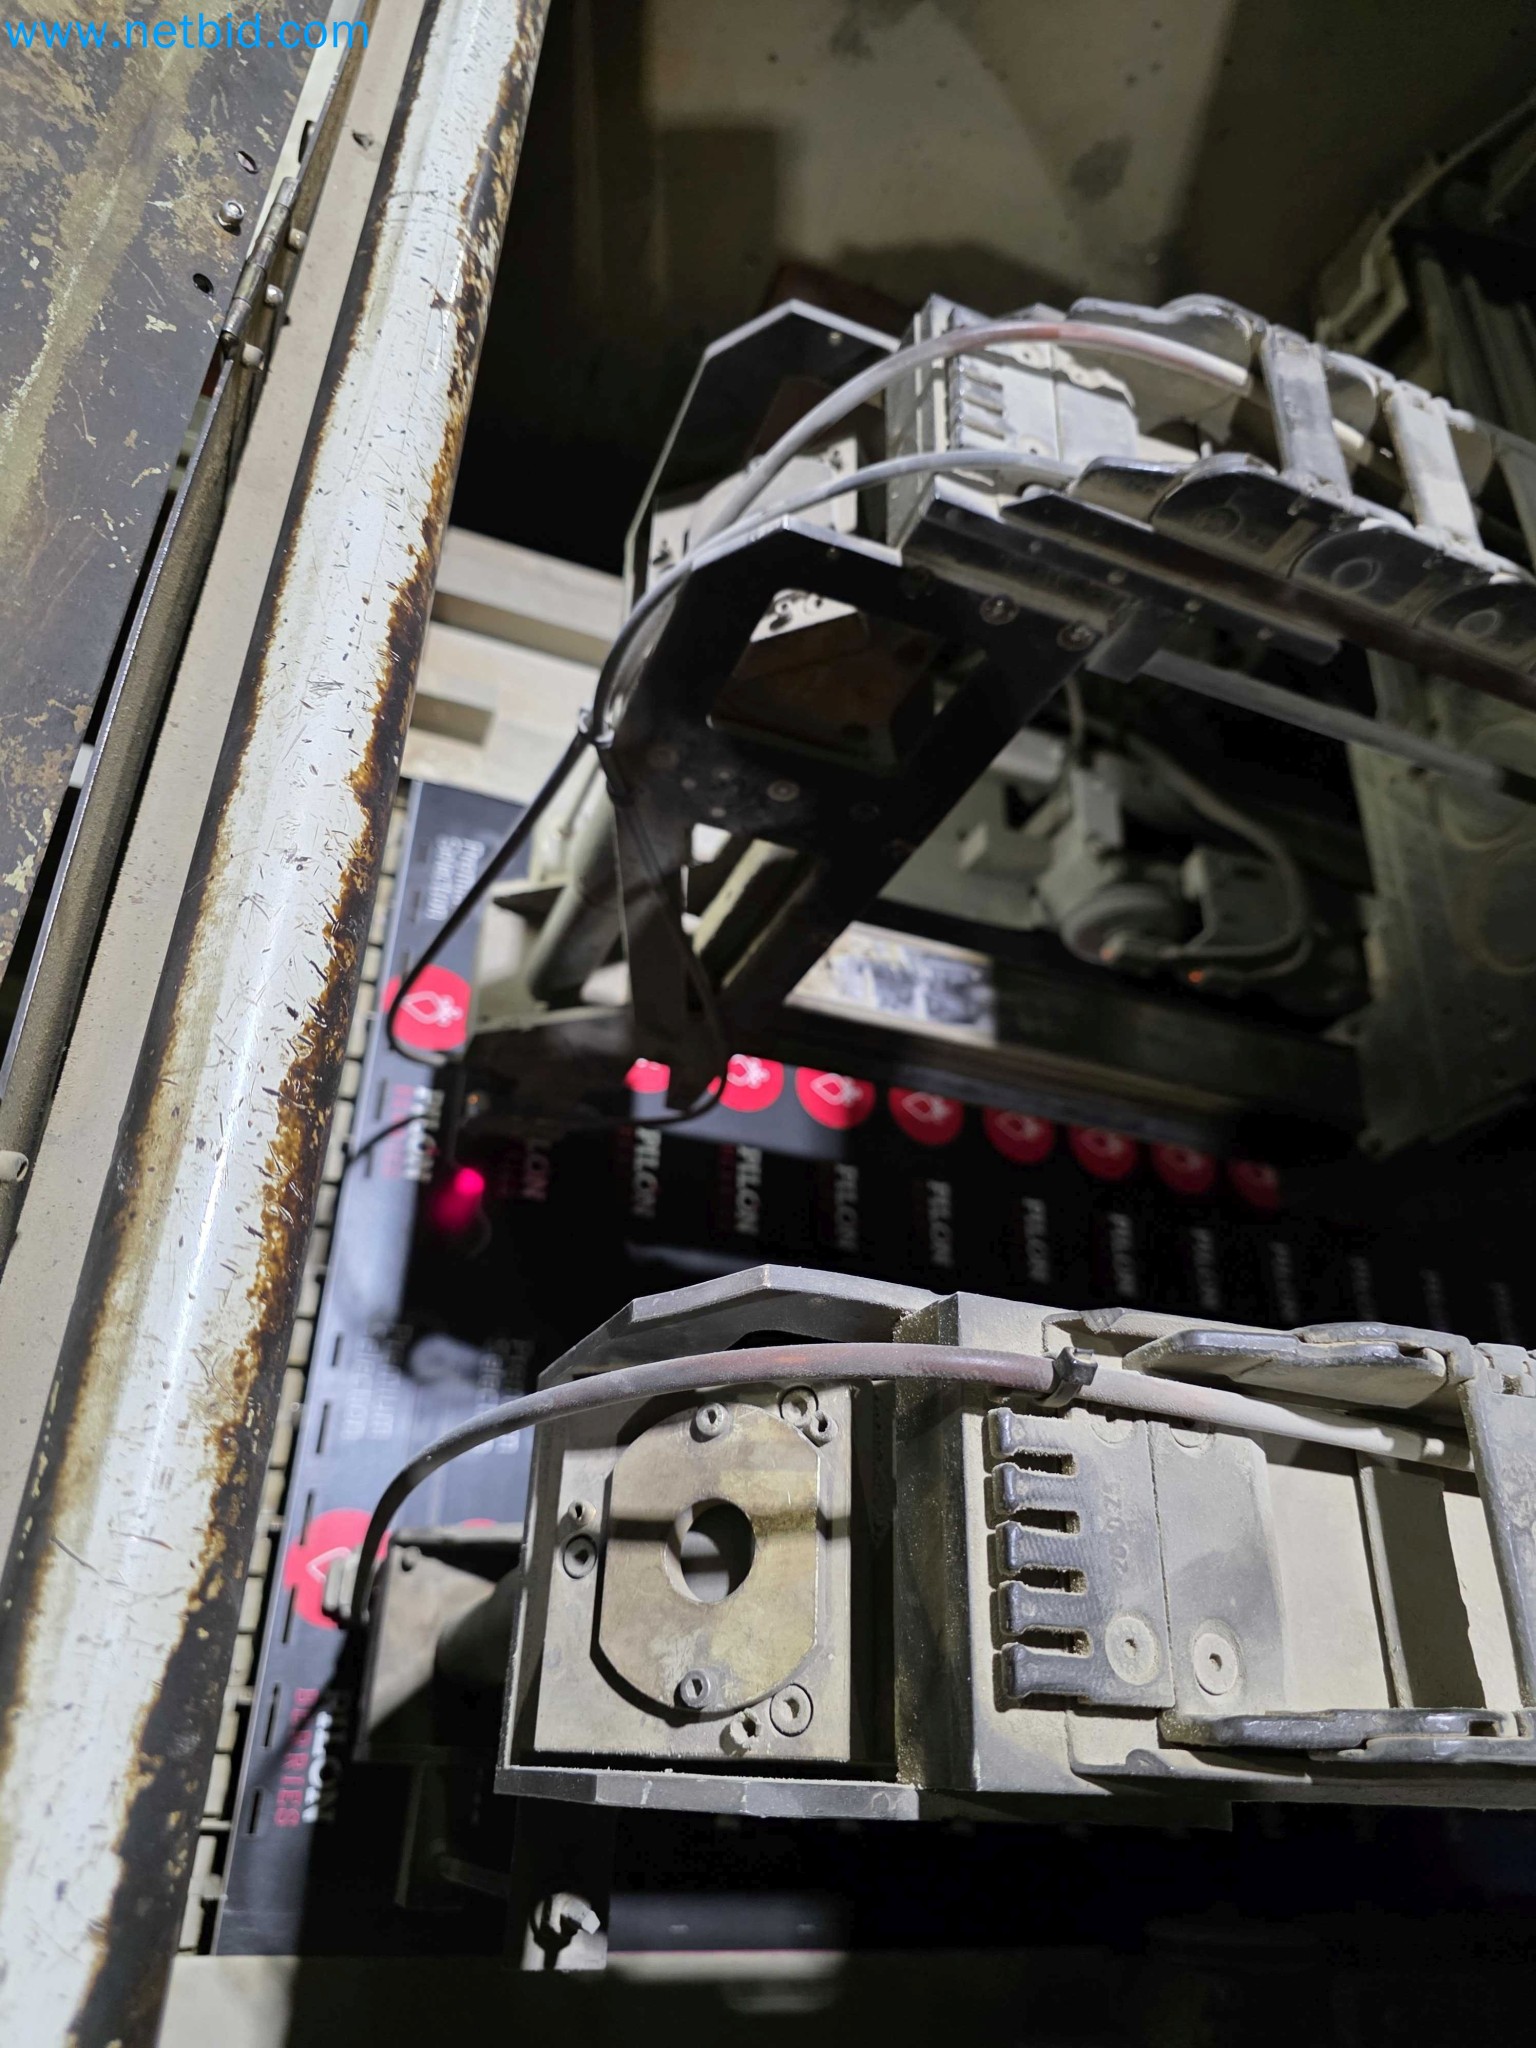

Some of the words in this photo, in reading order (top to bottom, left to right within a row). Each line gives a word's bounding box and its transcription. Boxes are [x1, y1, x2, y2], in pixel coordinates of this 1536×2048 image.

[631, 1127, 663, 1219] PILON
[734, 1146, 762, 1237] PILON
[833, 1163, 859, 1253] PILON
[273, 1687, 321, 1827] BERRIES
